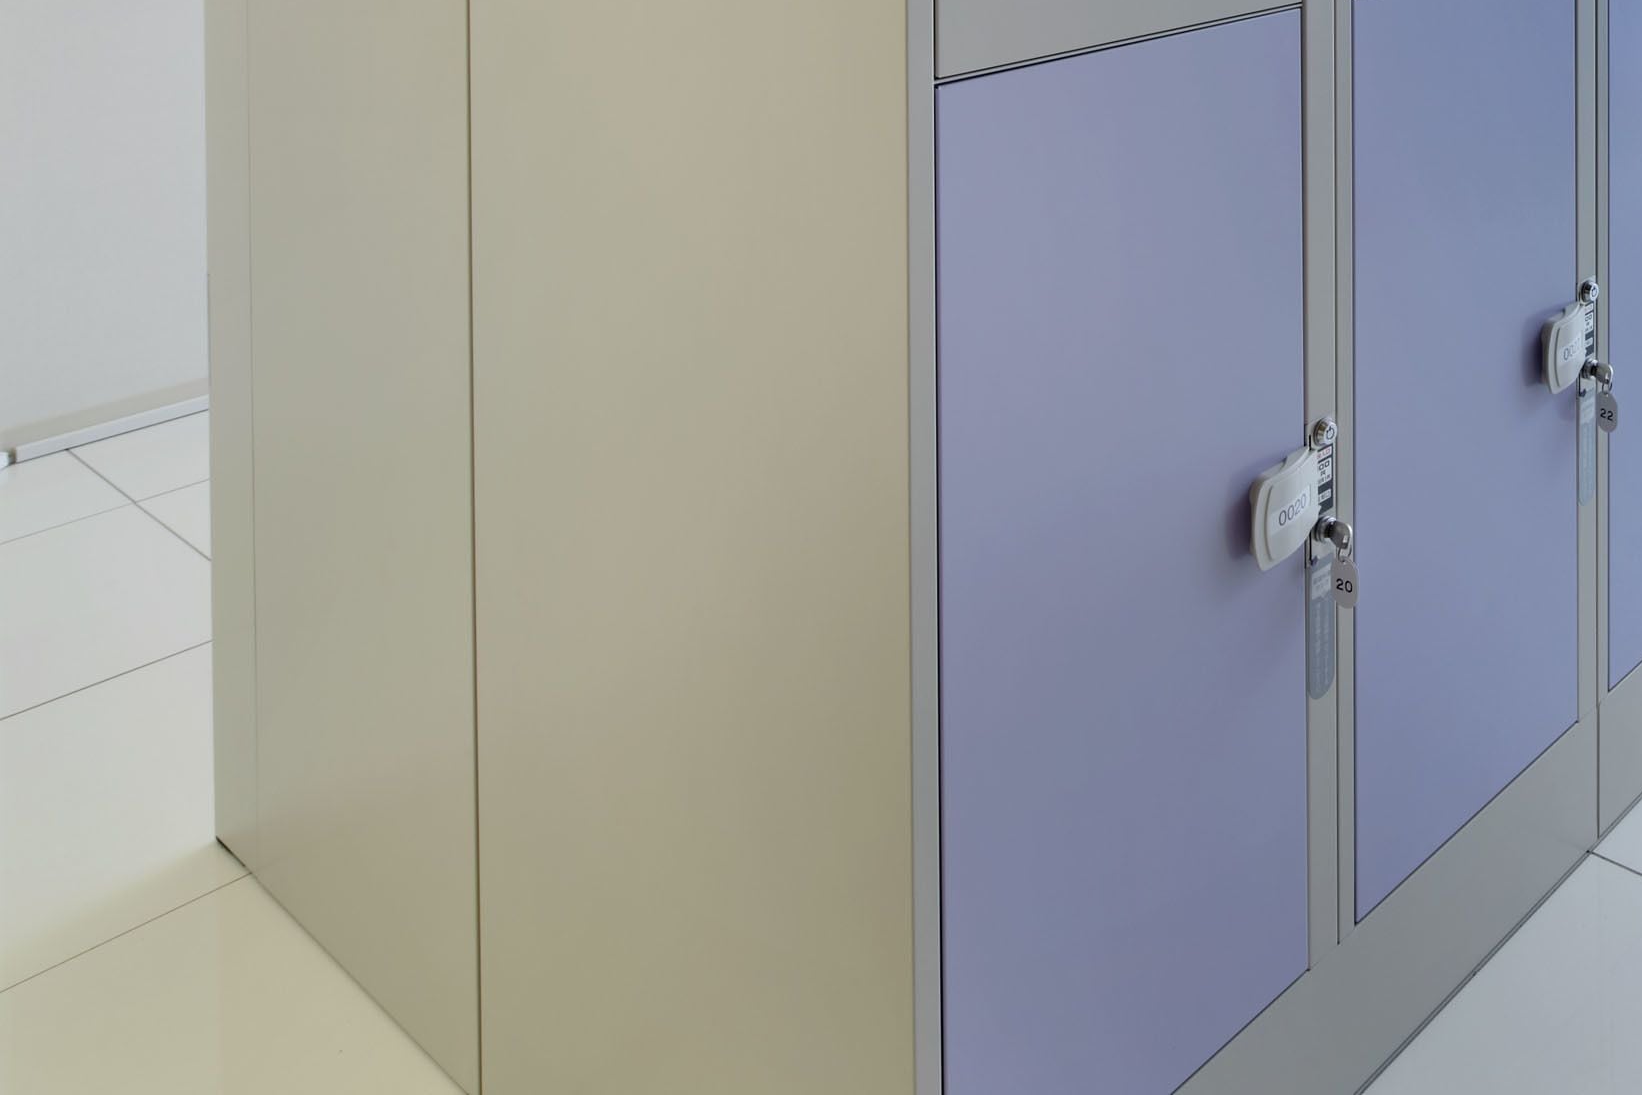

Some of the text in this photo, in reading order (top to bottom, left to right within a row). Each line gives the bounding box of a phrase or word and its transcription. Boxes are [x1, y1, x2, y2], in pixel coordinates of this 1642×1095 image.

[1600, 408, 1614, 421] 22
[1278, 493, 1306, 526] 0020
[1335, 577, 1353, 593] 20
